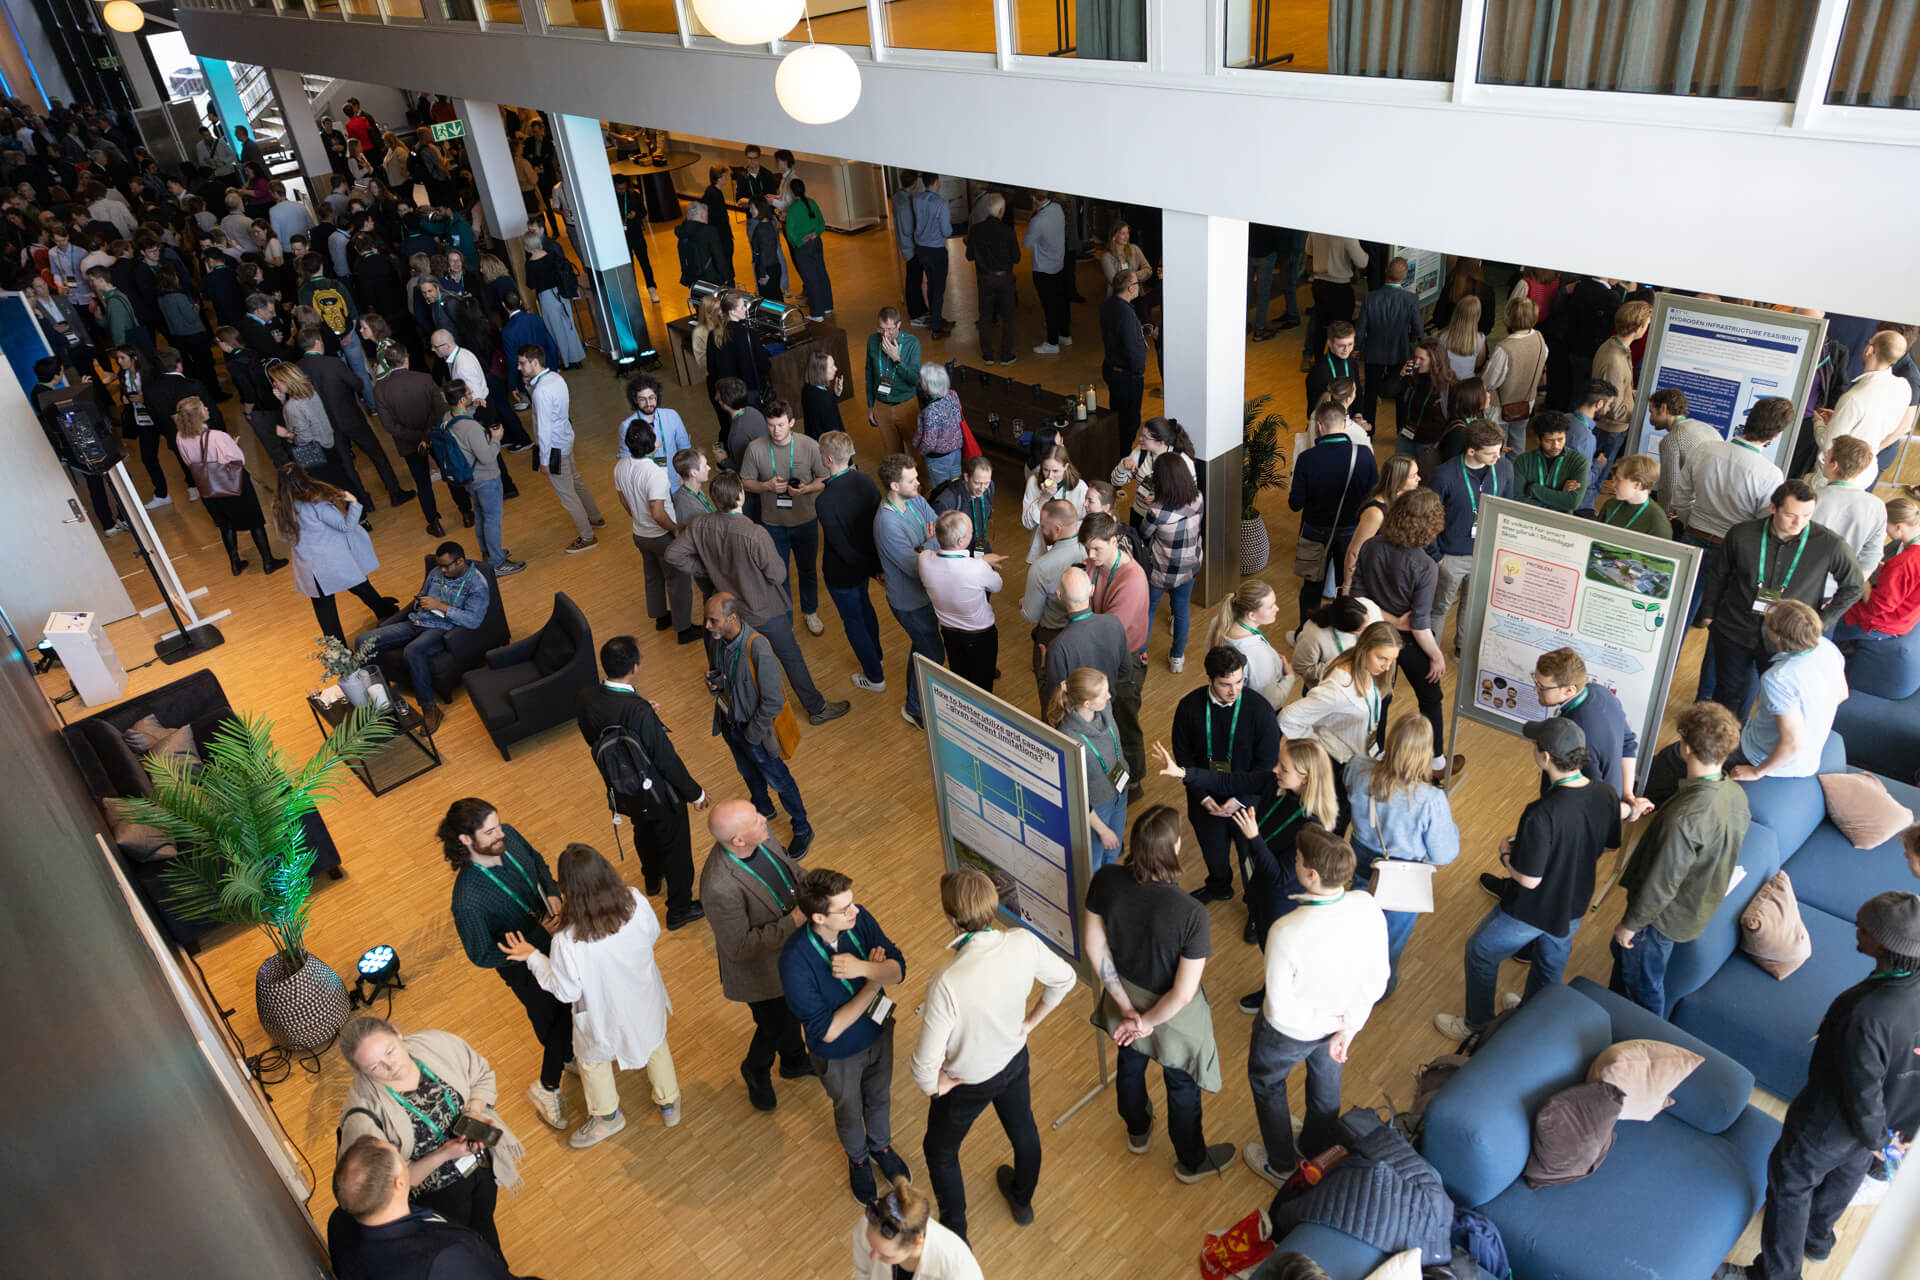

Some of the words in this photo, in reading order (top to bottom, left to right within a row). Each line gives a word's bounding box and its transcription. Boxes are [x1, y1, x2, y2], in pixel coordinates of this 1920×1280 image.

[1669, 315, 1705, 327] HYDROGEN
[1705, 321, 1762, 336] INFRASTRUCTURE
[1763, 331, 1802, 343] FEASIBILITY
[1526, 561, 1553, 572] PROBLEM
[934, 687, 949, 701] How
[949, 695, 957, 705] to
[958, 700, 980, 718] better
[981, 712, 1004, 732] utilize
[1005, 727, 1021, 741] grid
[1021, 739, 1056, 762] capacity
[970, 716, 997, 736] current
[998, 732, 1043, 762] limitations?
